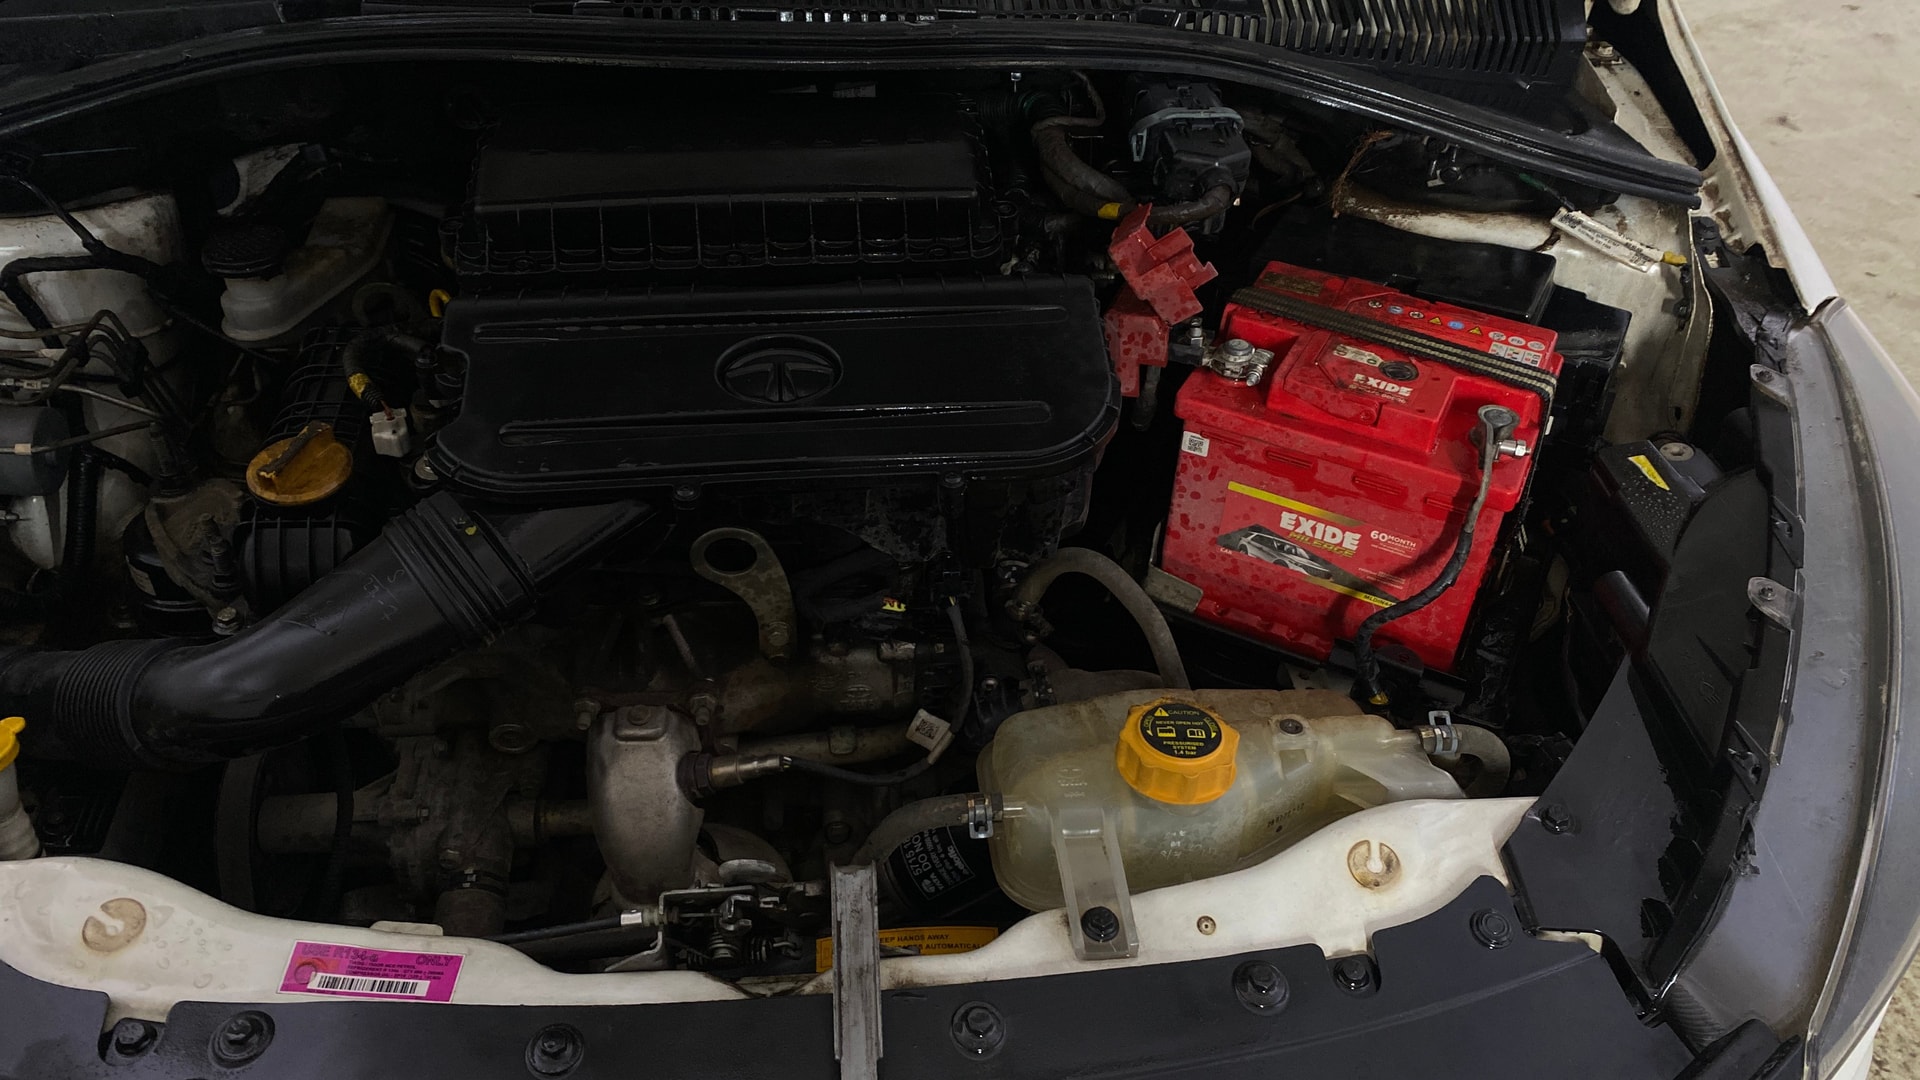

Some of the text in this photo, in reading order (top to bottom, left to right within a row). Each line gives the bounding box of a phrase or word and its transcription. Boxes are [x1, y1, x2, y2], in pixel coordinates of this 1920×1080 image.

[1353, 373, 1413, 397] EXIDE
[1280, 511, 1362, 552] EXIDE
[1370, 530, 1417, 548] 60 MONTH
[1220, 547, 1233, 555] CAR
[1288, 532, 1356, 559] MILEAGE
[917, 853, 932, 872] DO
[879, 936, 896, 944] EEP
[897, 934, 925, 943] HANDS
[302, 944, 331, 957] USE
[416, 954, 453, 967] ONLY
